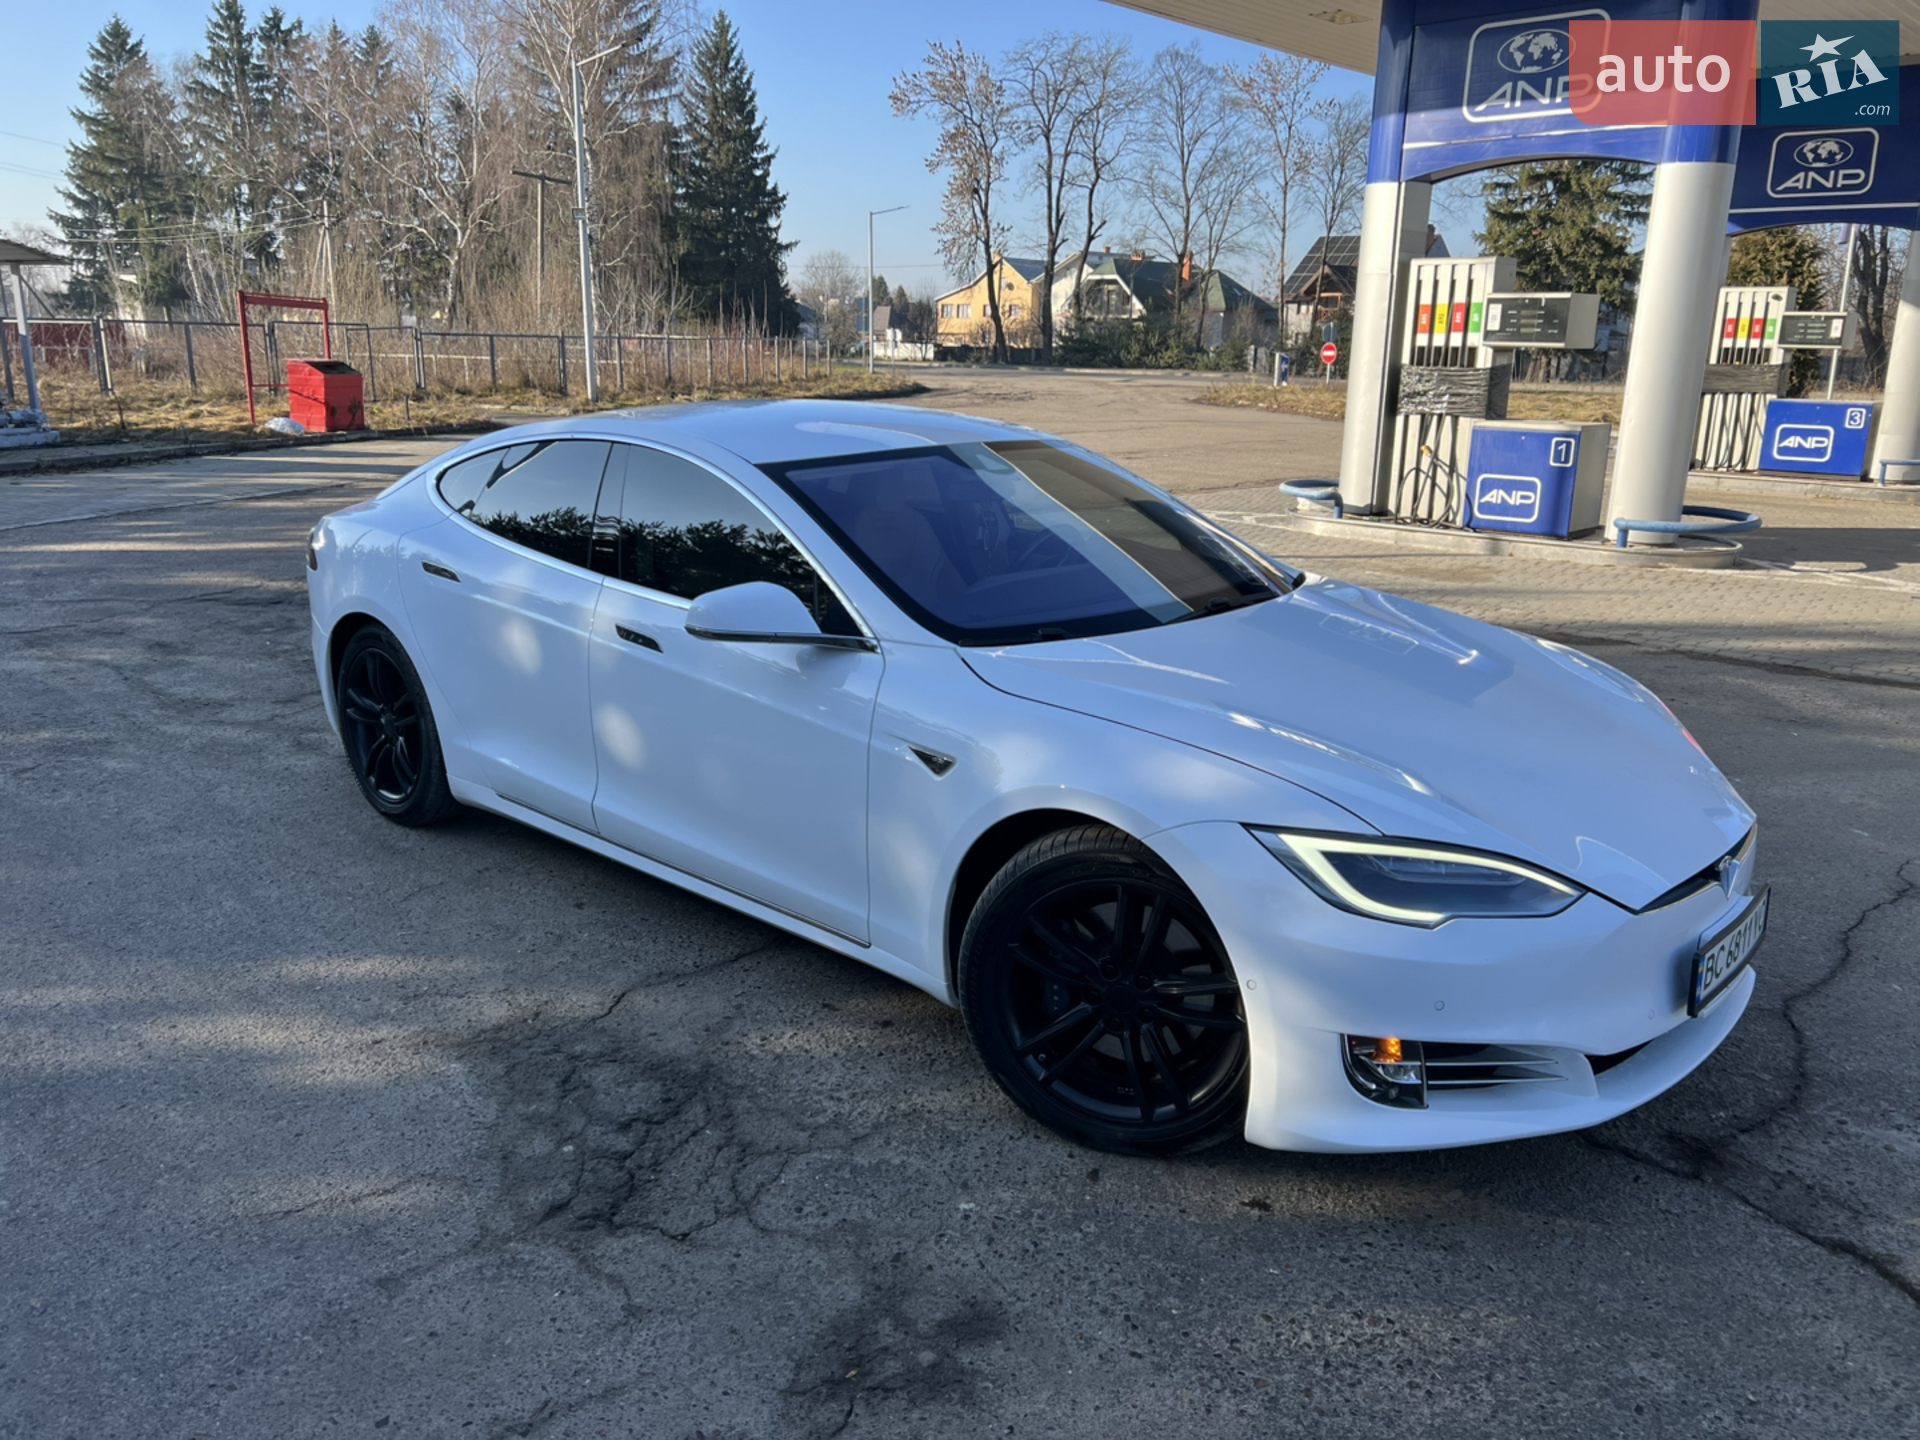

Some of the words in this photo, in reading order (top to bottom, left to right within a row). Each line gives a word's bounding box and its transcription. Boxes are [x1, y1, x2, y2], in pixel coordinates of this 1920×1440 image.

[1474, 73, 1594, 112] ANP
[1775, 168, 1866, 191] ANP
[1850, 411, 1861, 425] 3
[1557, 442, 1567, 462] 1
[1778, 435, 1829, 449] ANP
[1479, 488, 1536, 506] ANP
[1703, 944, 1726, 991] BC
